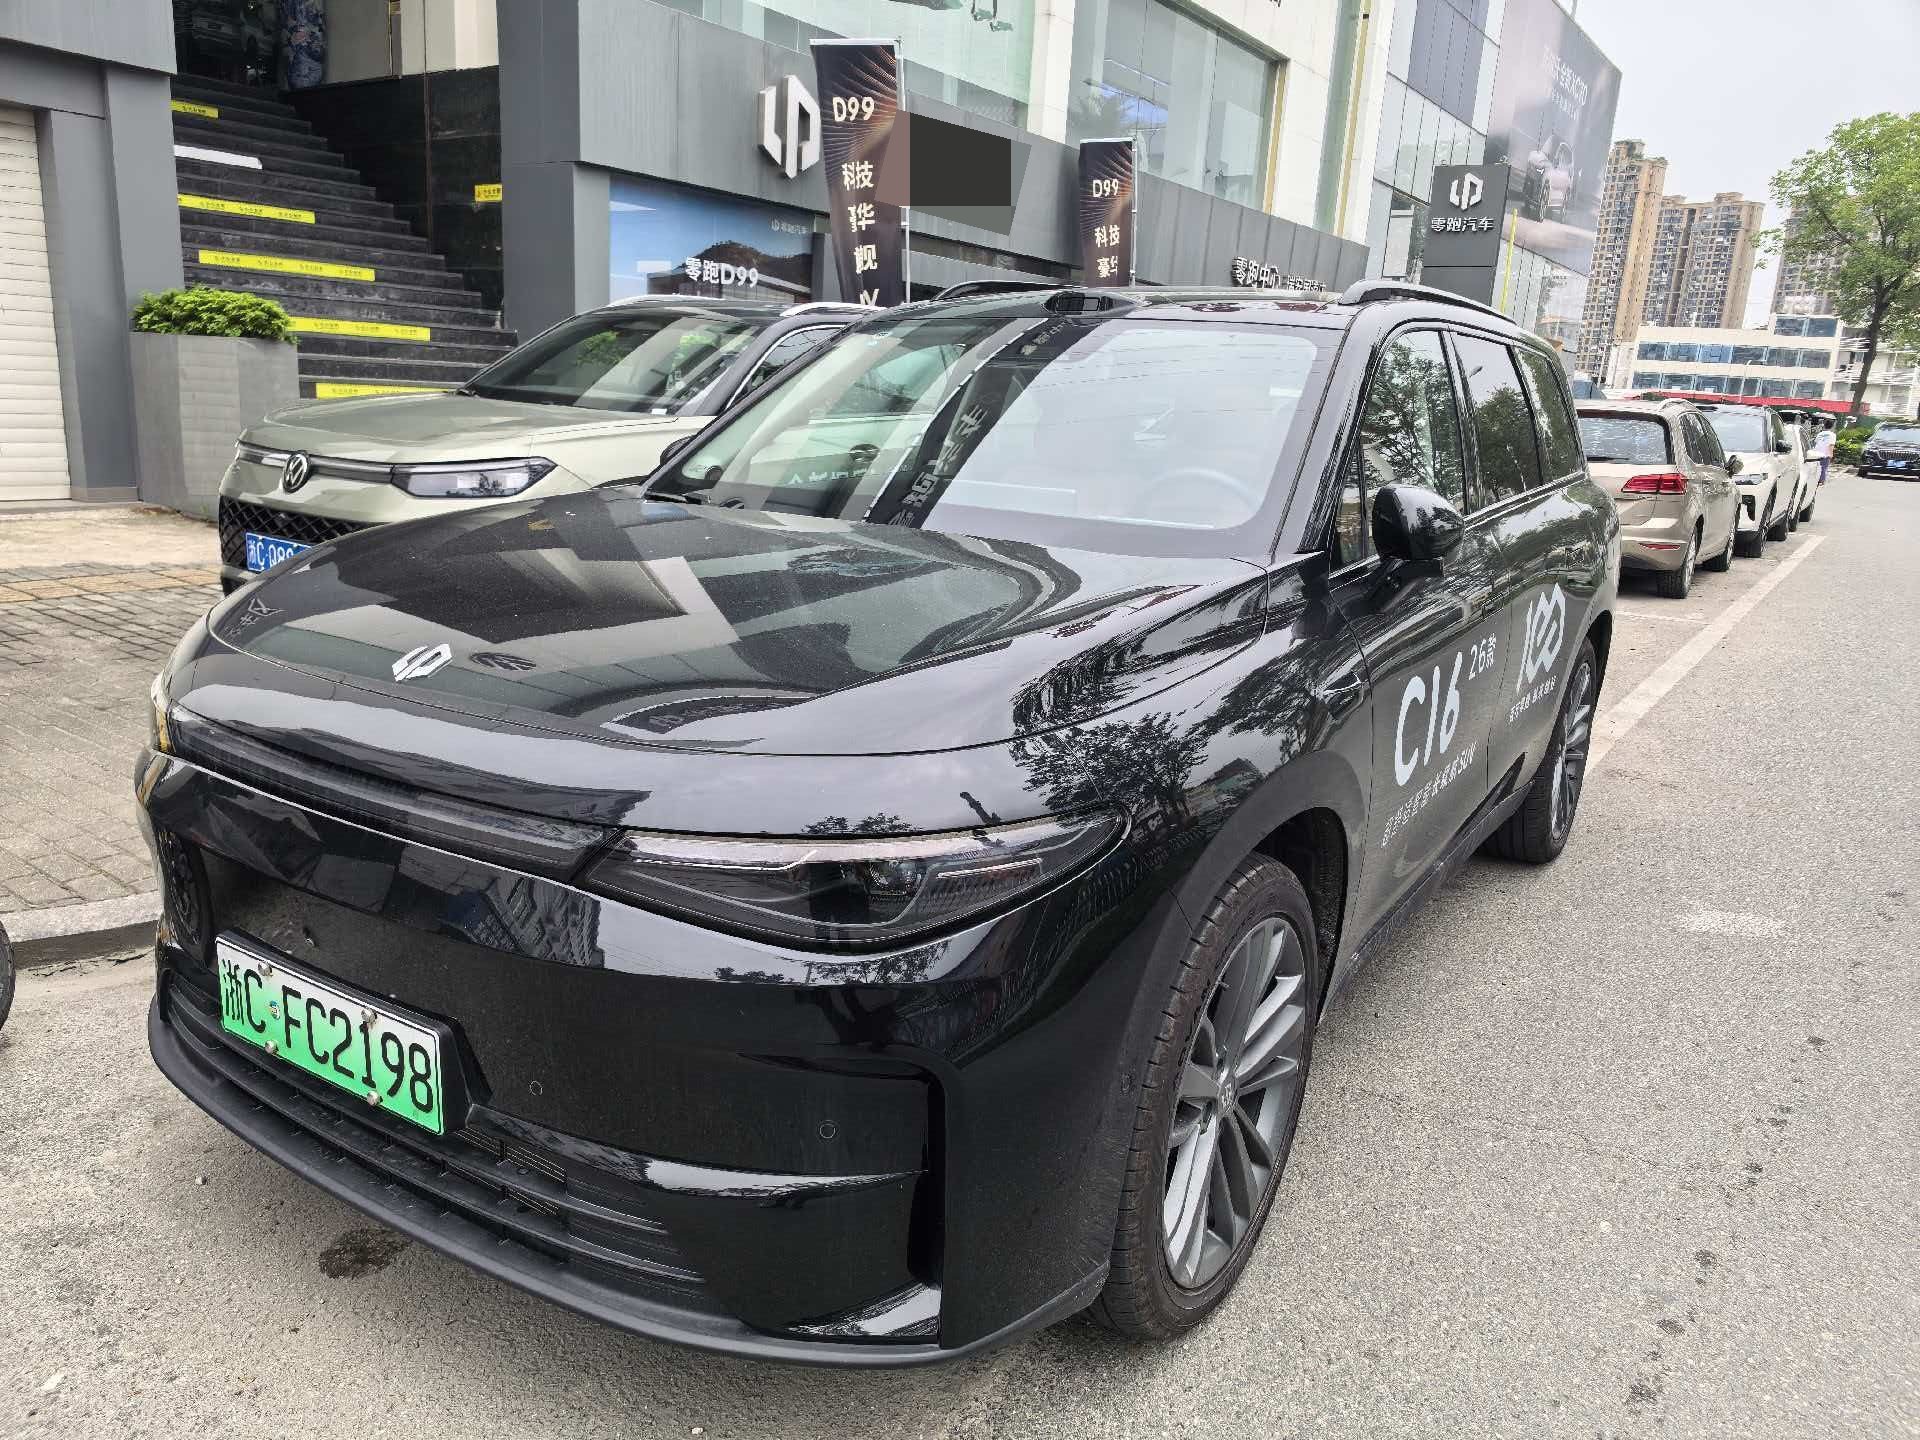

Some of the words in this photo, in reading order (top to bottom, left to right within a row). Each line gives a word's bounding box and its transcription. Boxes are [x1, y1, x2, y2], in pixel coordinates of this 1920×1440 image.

[832, 96, 875, 122] D99
[841, 160, 875, 191] 科技
[1093, 178, 1119, 198] D99
[1095, 224, 1120, 248] 科技
[1431, 216, 1494, 232] 零跑汽车
[685, 256, 759, 289] 零跑D99
[1395, 651, 1463, 787] C16
[1468, 632, 1497, 680] 26款
